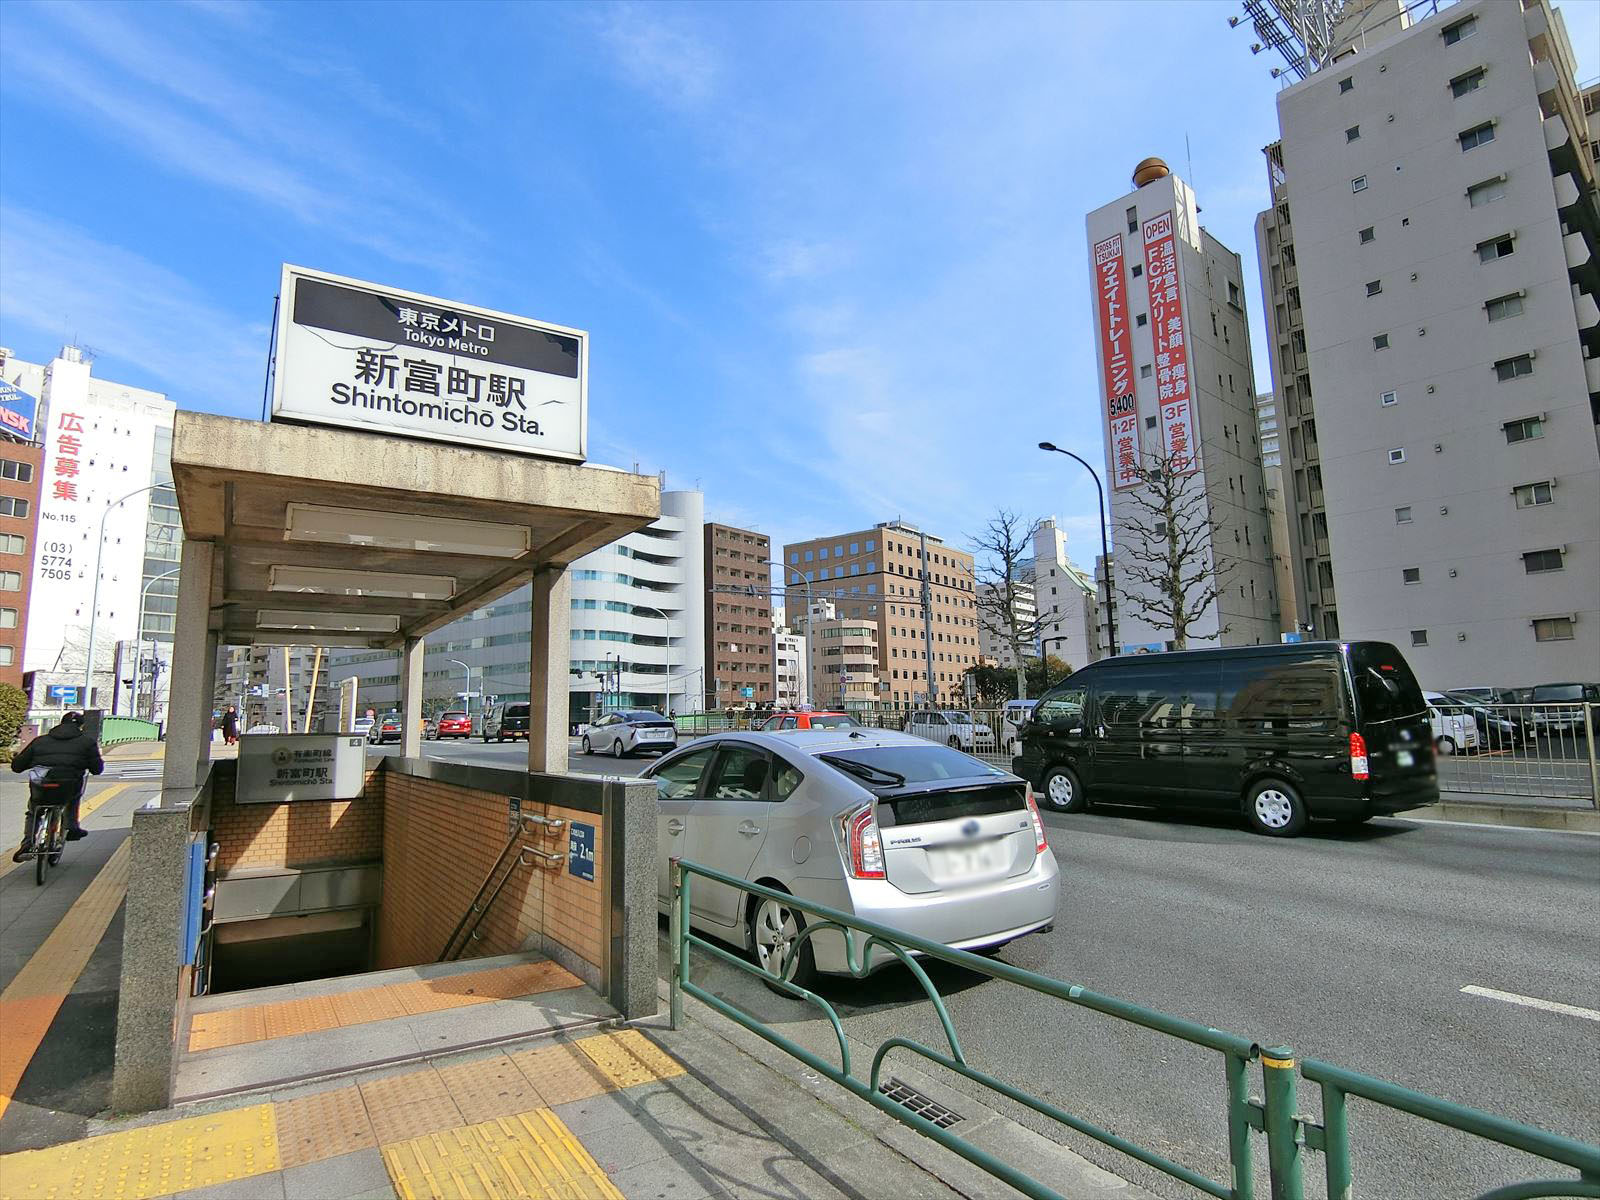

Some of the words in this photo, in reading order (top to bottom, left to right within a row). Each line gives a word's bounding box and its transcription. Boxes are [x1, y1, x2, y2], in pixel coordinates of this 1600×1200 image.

[1146, 218, 1169, 239] OPEN
[397, 306, 496, 343] 東京メトロ
[1148, 246, 1174, 400] FCアスリート整骨院
[403, 328, 445, 348] Tokyo
[448, 337, 489, 356] Metro
[354, 350, 527, 411] 新富町駅
[0, 407, 30, 434] NSK
[331, 382, 494, 428] Shintomichō
[501, 411, 545, 436] Sta.
[1165, 403, 1187, 420] 3F
[52, 413, 84, 501] 広告募集
[1118, 436, 1136, 482] 営業中
[1168, 422, 1189, 471] 営業中
[41, 555, 72, 567] 5774
[44, 541, 73, 554] (03)
[41, 568, 71, 580] 7505
